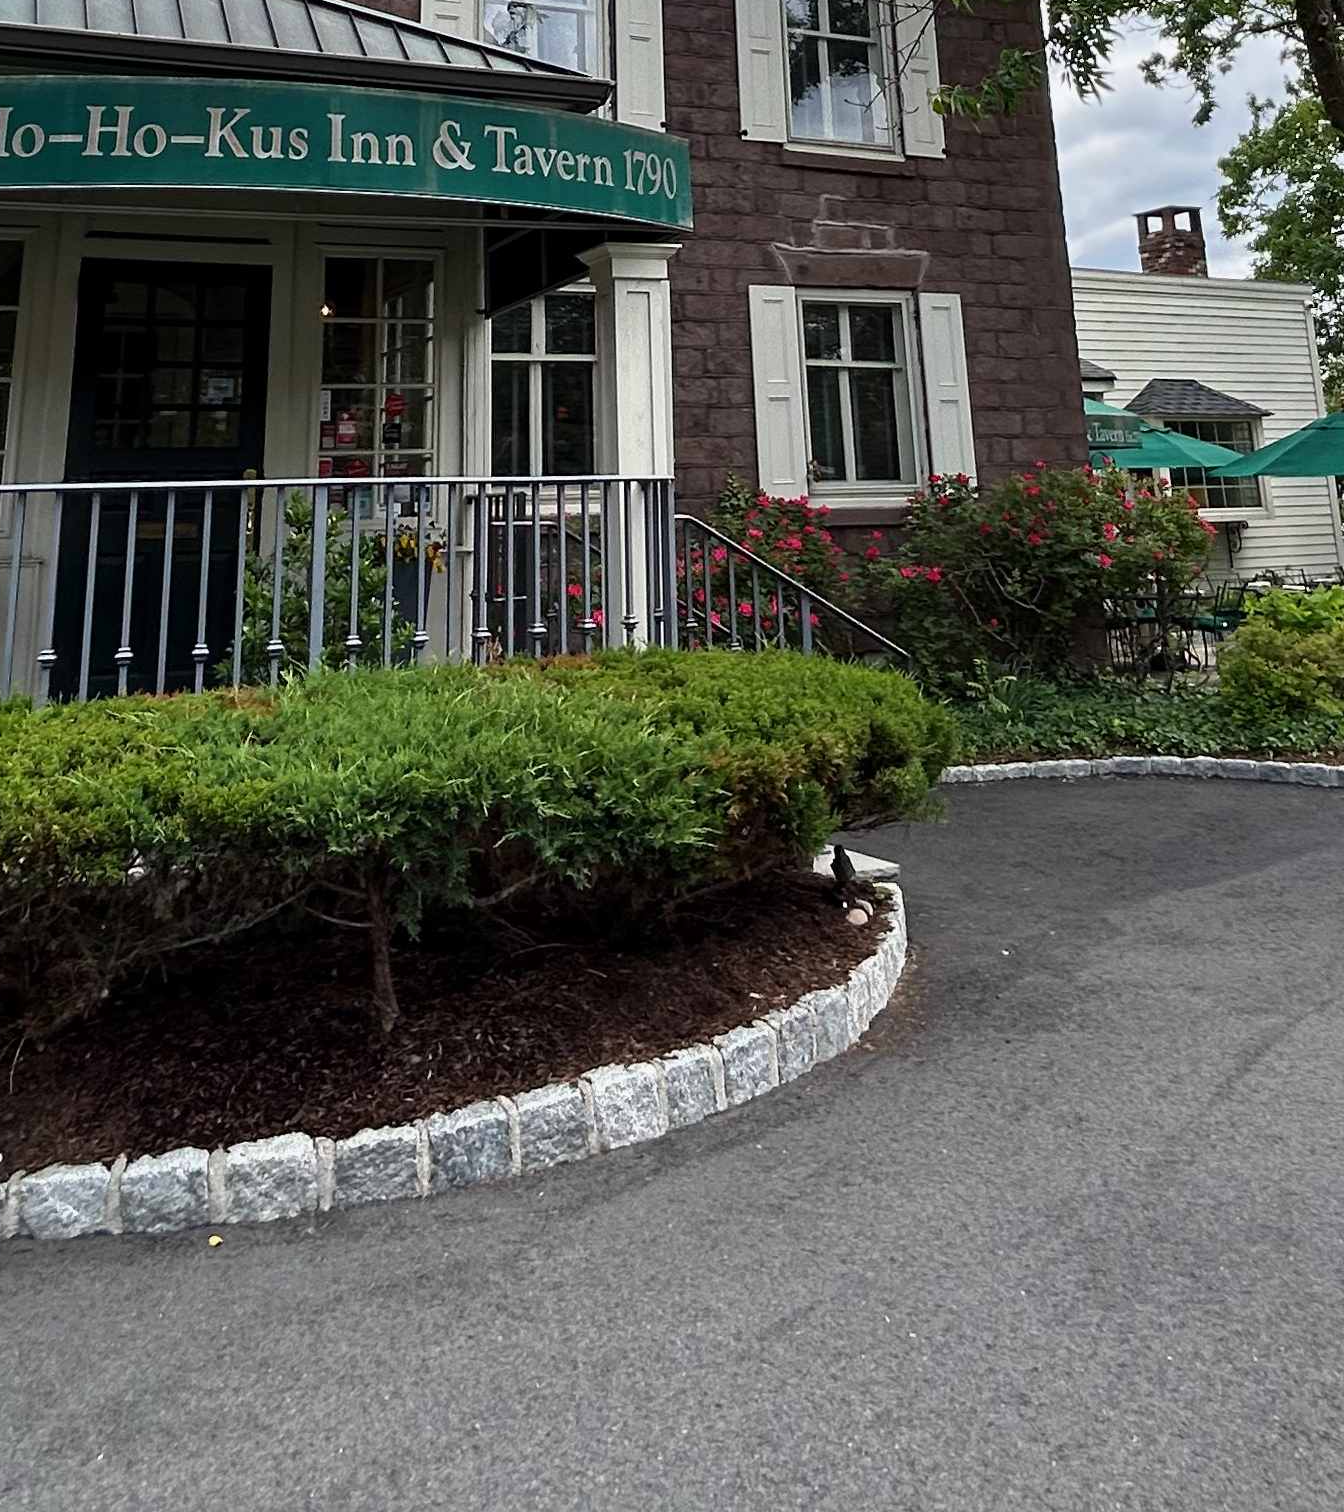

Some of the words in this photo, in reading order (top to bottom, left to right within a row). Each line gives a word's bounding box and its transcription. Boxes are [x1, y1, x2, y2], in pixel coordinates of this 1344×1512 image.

[326, 113, 417, 167] Inn
[432, 120, 476, 171] &
[484, 125, 615, 187] Tavern
[622, 148, 677, 200] 1790
